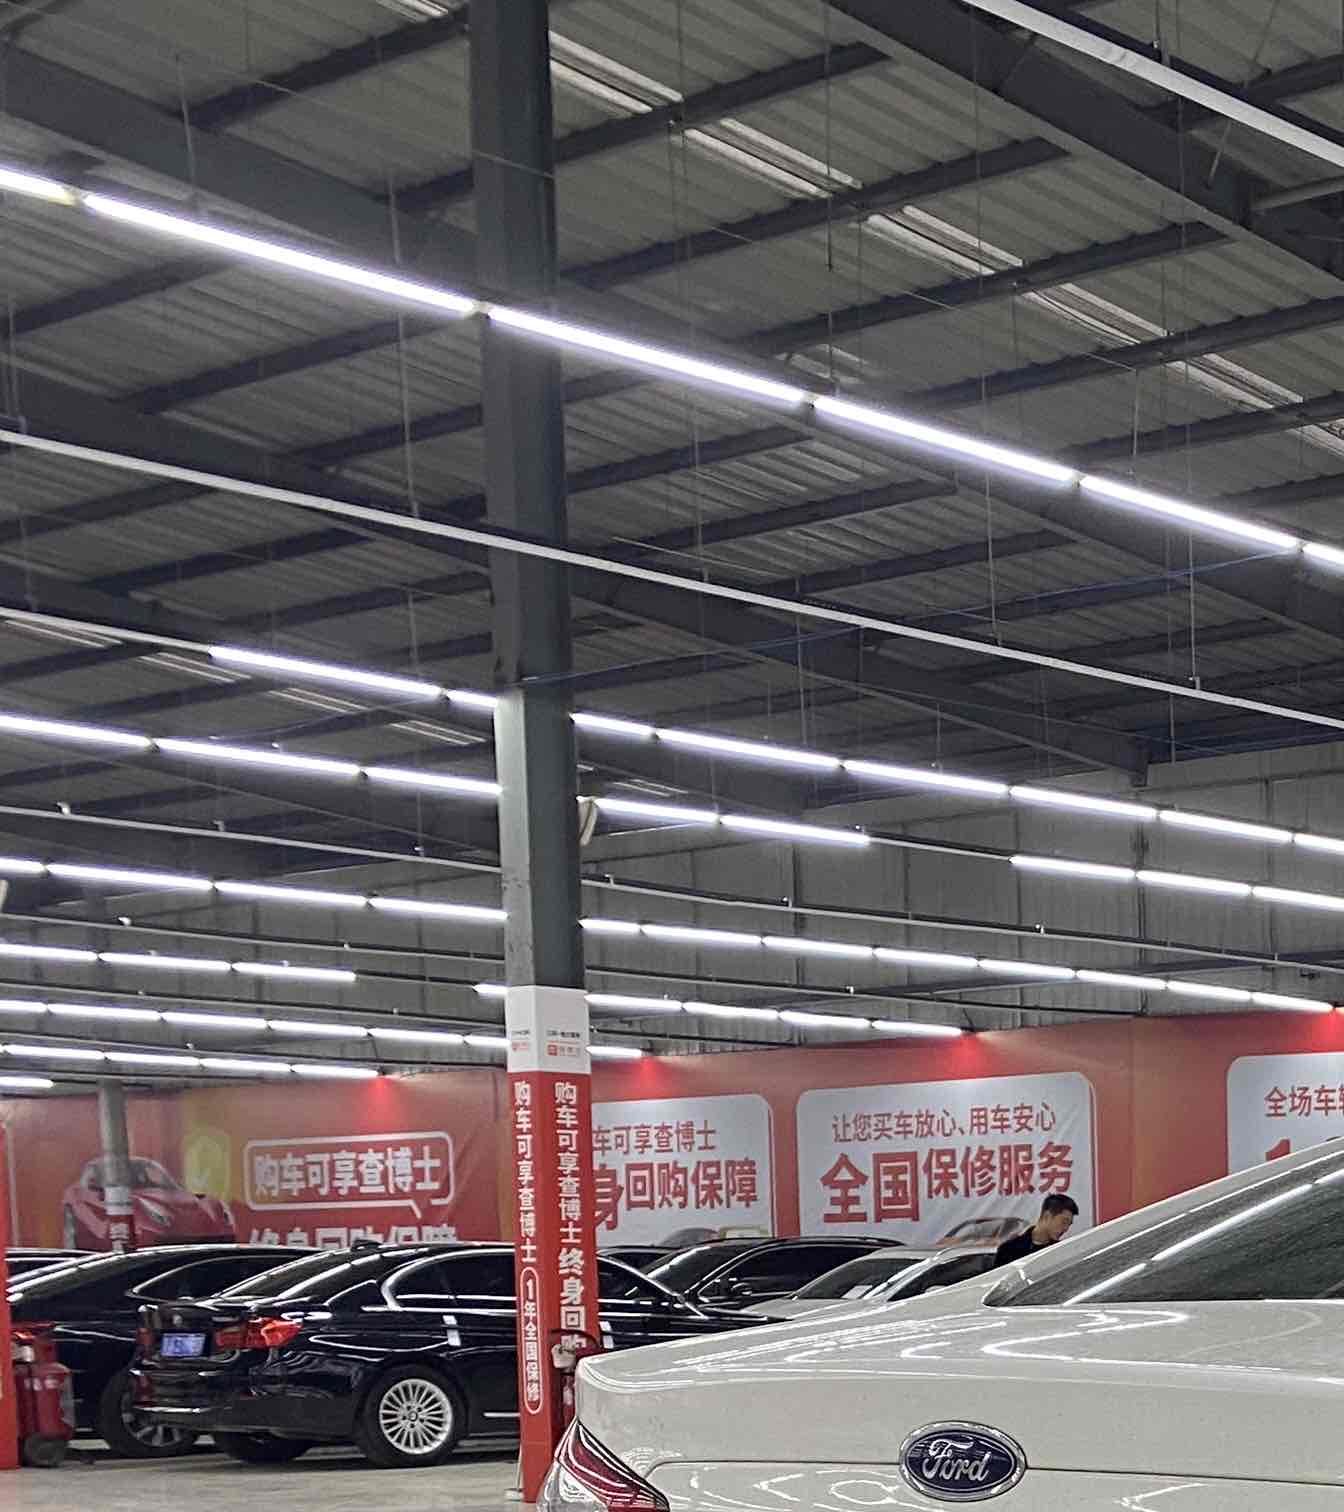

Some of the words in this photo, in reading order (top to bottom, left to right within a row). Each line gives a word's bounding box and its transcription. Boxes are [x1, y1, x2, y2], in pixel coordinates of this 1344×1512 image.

[832, 1102, 1056, 1144] 让您买车放心、用车安心
[254, 1145, 441, 1197] 购车可享查博士
[514, 1081, 537, 1262] 购车可享查博士
[820, 1141, 1074, 1224] 全国保修服务
[922, 1438, 993, 1481] Ford
